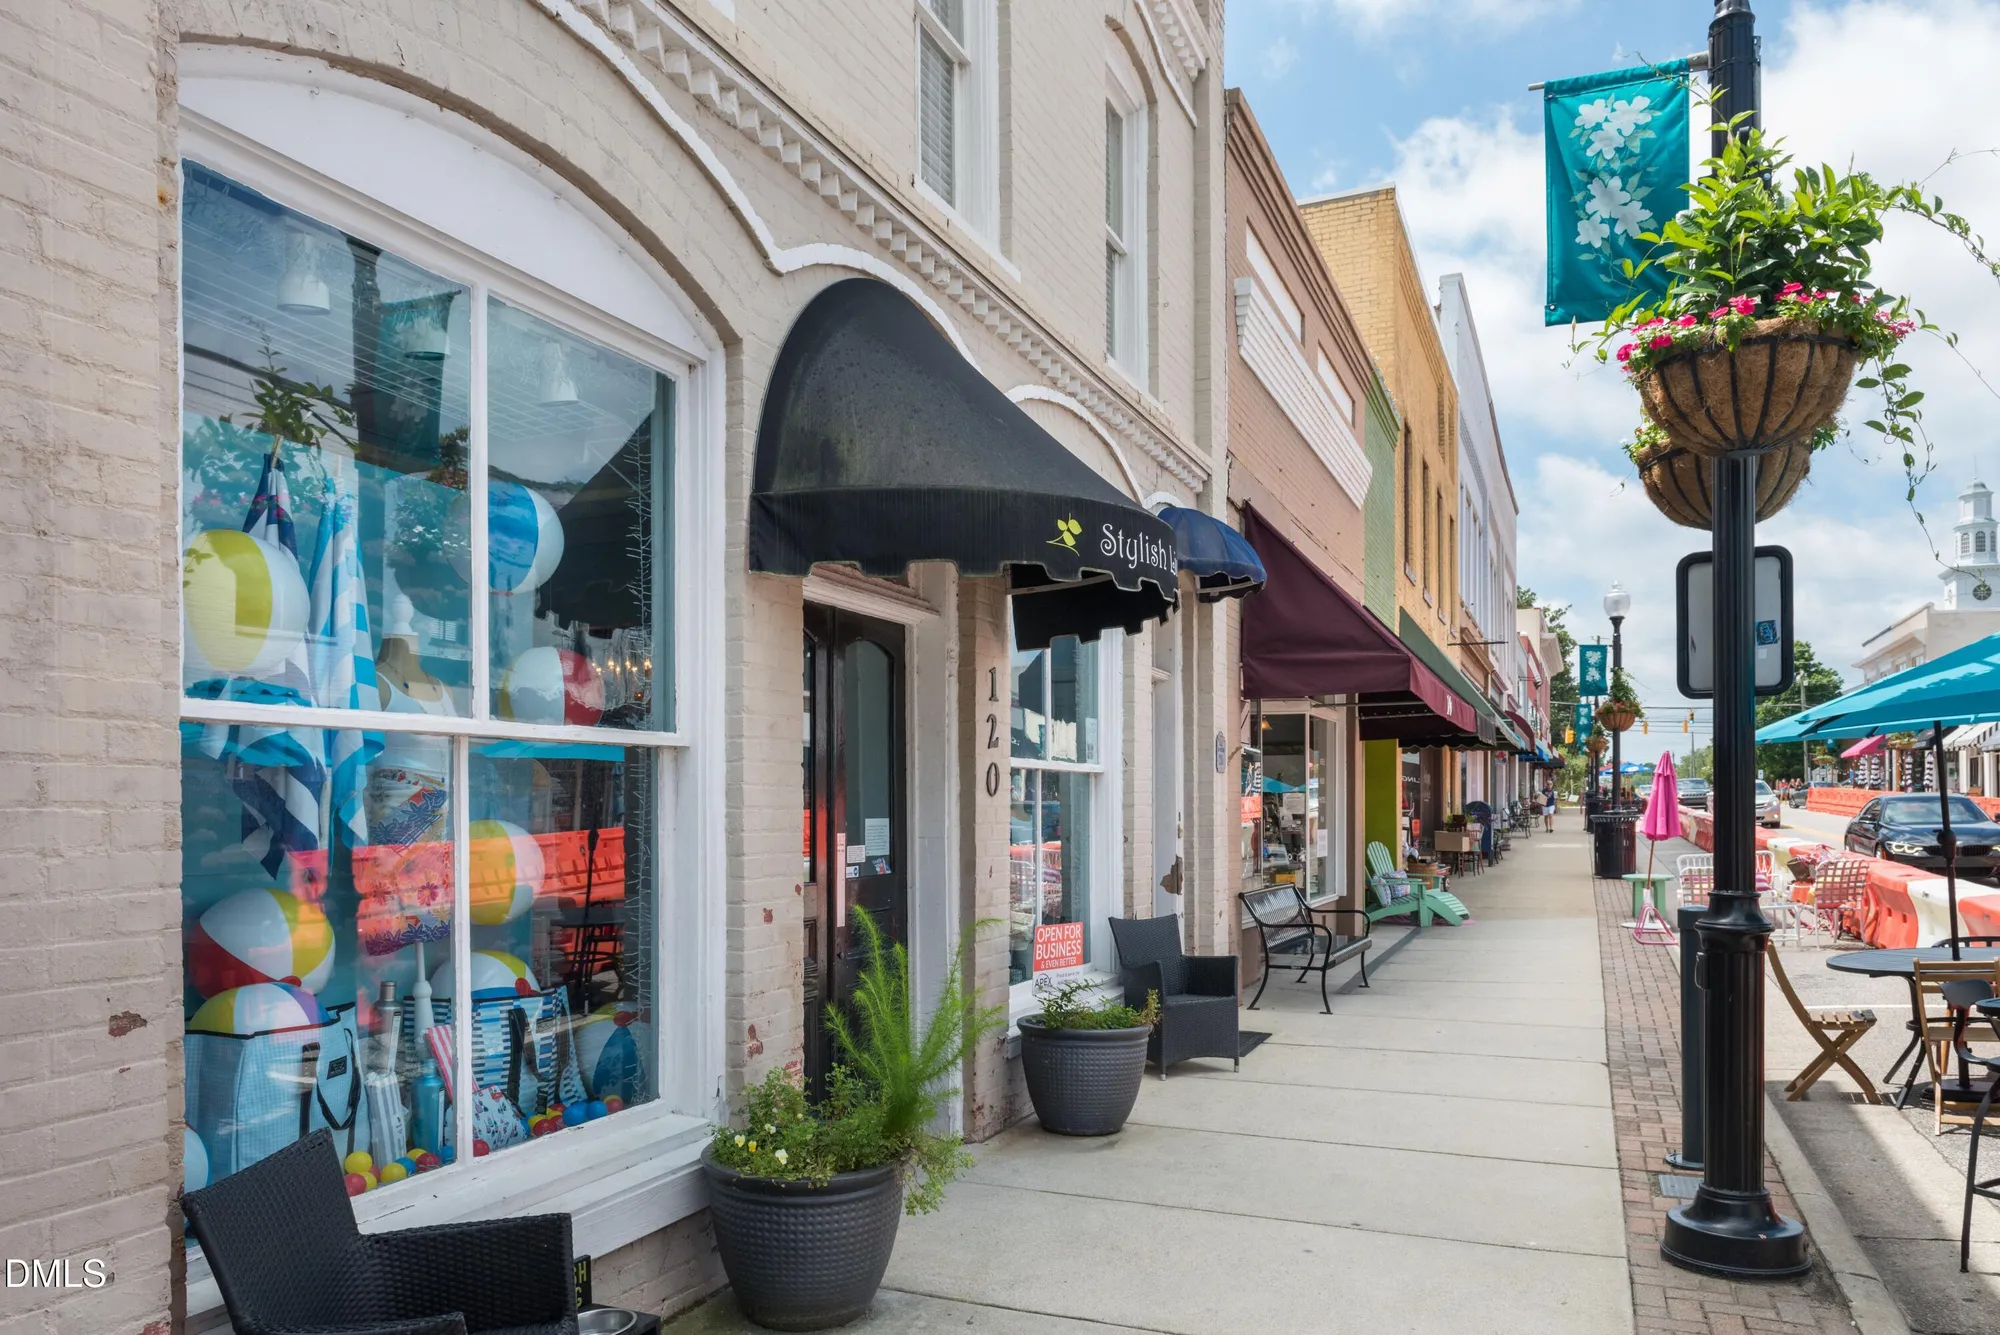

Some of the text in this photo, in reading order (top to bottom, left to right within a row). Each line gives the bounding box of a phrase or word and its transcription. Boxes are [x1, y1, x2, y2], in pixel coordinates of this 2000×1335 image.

[1100, 523, 1167, 569] Stylish
[986, 666, 1000, 797] 120
[1037, 924, 1081, 942] OPEN FOR
[1036, 940, 1081, 960] BUSINESS
[1041, 957, 1076, 969] & EVEN BETTER
